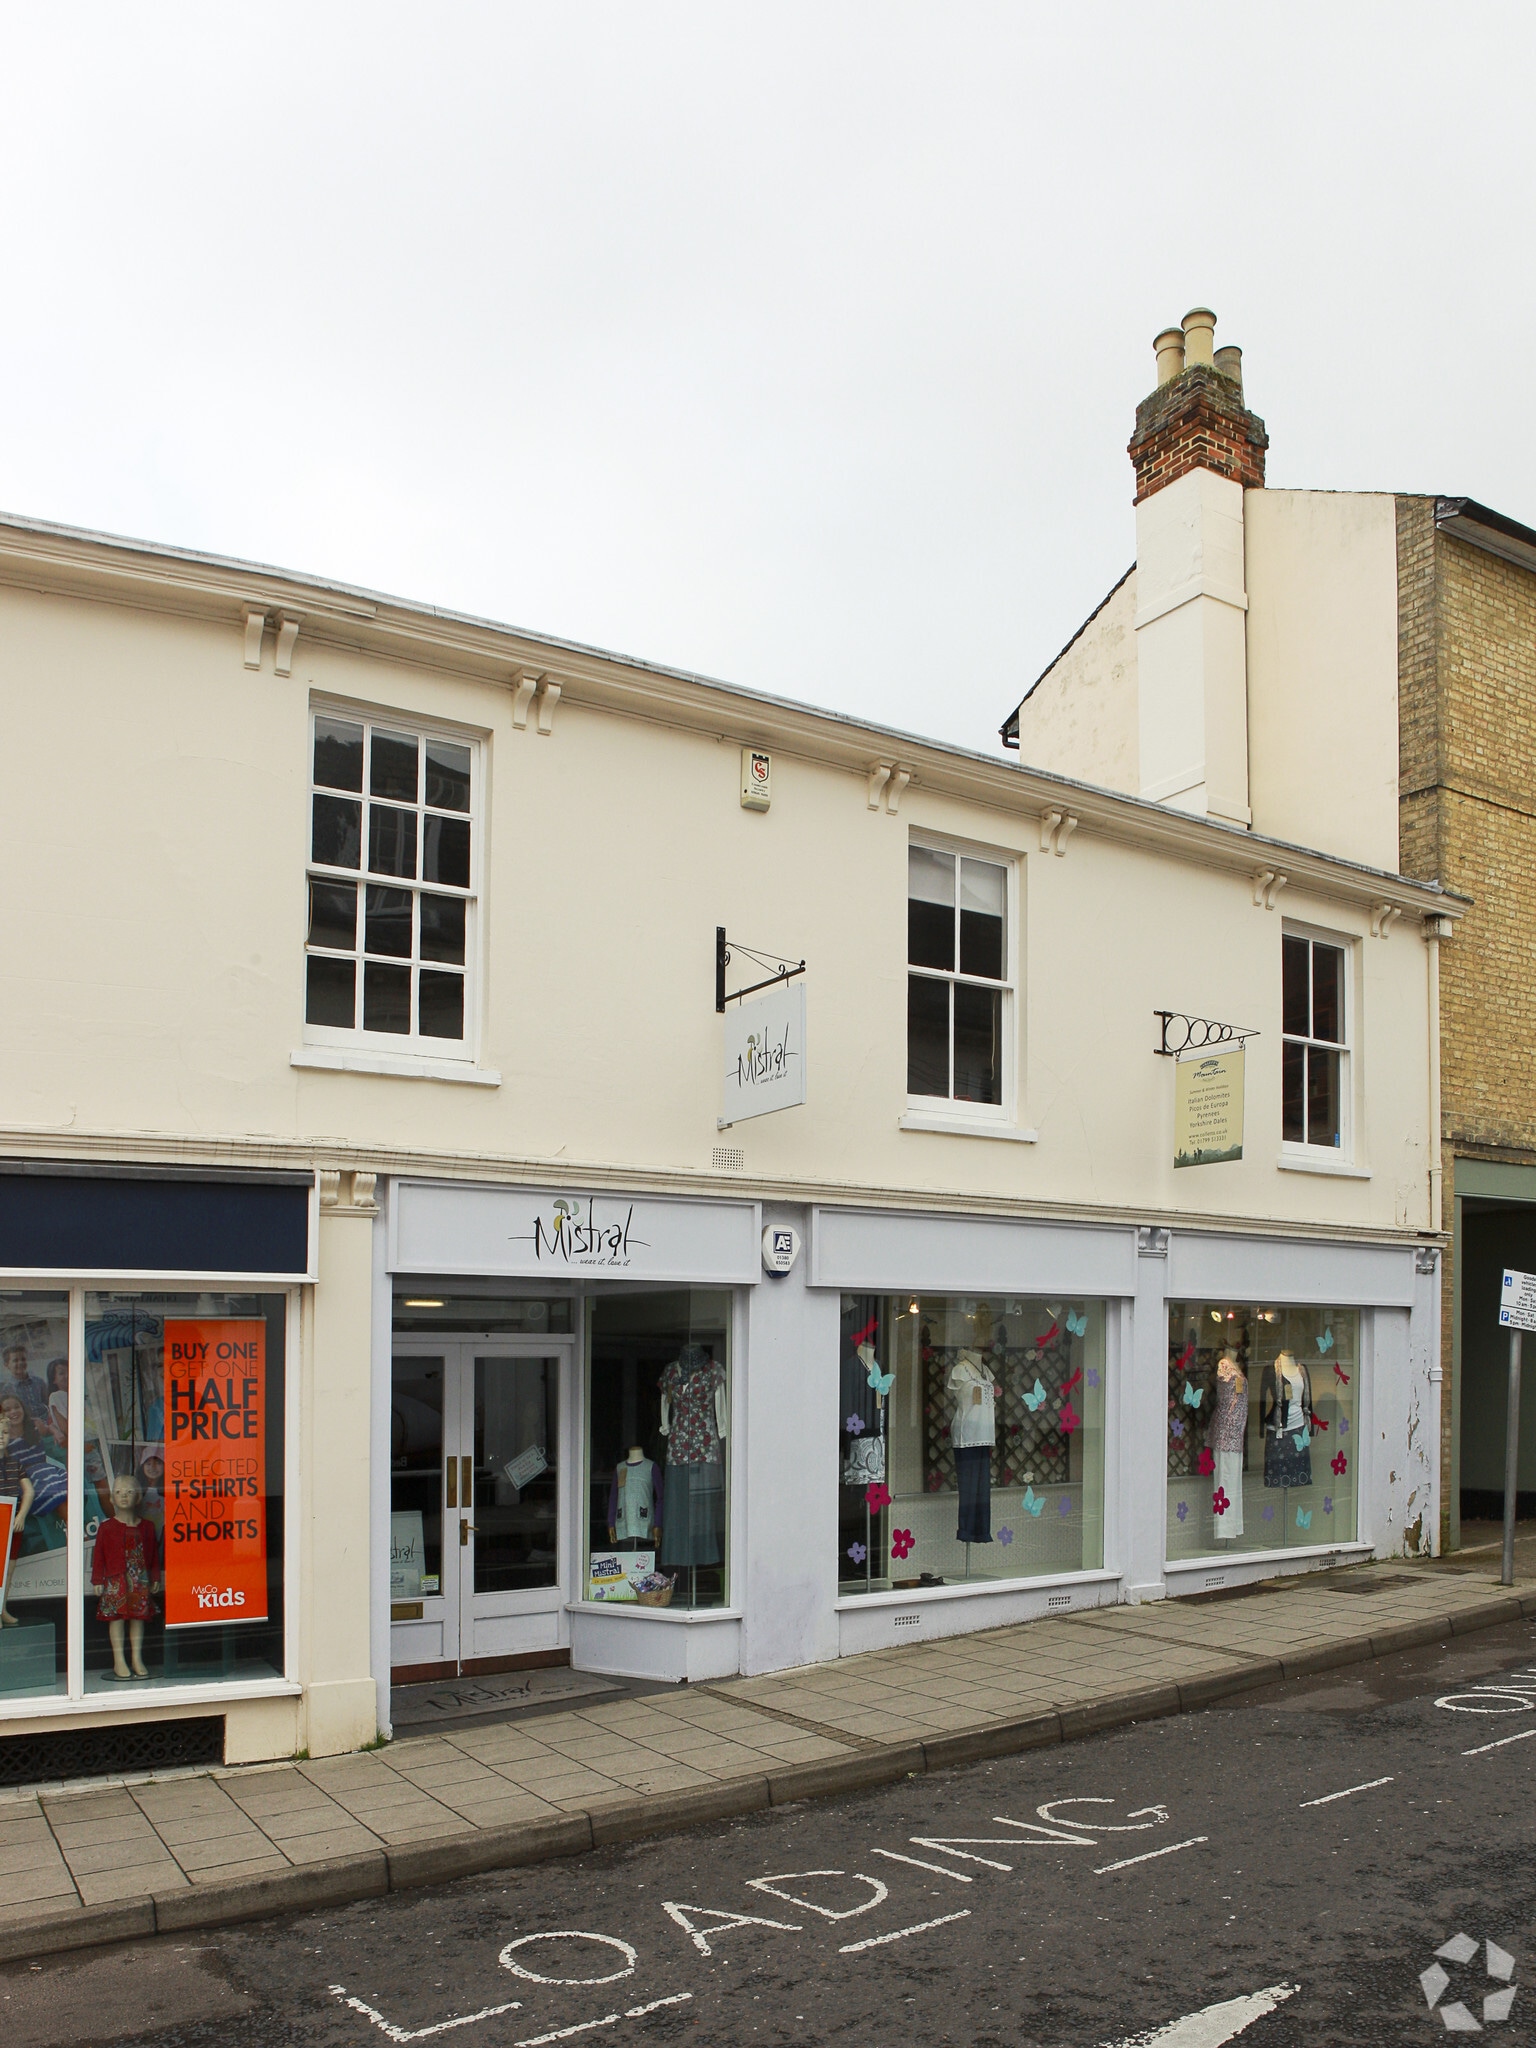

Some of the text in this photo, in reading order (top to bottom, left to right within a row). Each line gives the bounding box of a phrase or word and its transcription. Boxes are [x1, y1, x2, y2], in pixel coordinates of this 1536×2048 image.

[726, 1022, 799, 1088] Mistral
[1204, 1092, 1230, 1101] Dolomites
[1211, 1101, 1229, 1109] Europa
[1190, 1119, 1212, 1128] Yorkshire
[1197, 1110, 1220, 1119] Pyrenees
[508, 1197, 651, 1262] Mistral
[607, 1257, 622, 1266] love
[171, 1342, 258, 1360] BUY ONE
[169, 1360, 258, 1378] GET ONE
[171, 1378, 258, 1411] HALF
[171, 1409, 258, 1440] PRICE
[171, 1458, 259, 1478] SELECTED
[172, 1476, 258, 1499] T-SHIRTS
[172, 1499, 225, 1521] AND
[173, 1518, 258, 1543] SHORTS
[594, 1566, 621, 1577] Mistral
[600, 1560, 616, 1570] Mini
[10, 1578, 66, 1589] NLINE MOBILE
[327, 1797, 1171, 2042] LOADING
